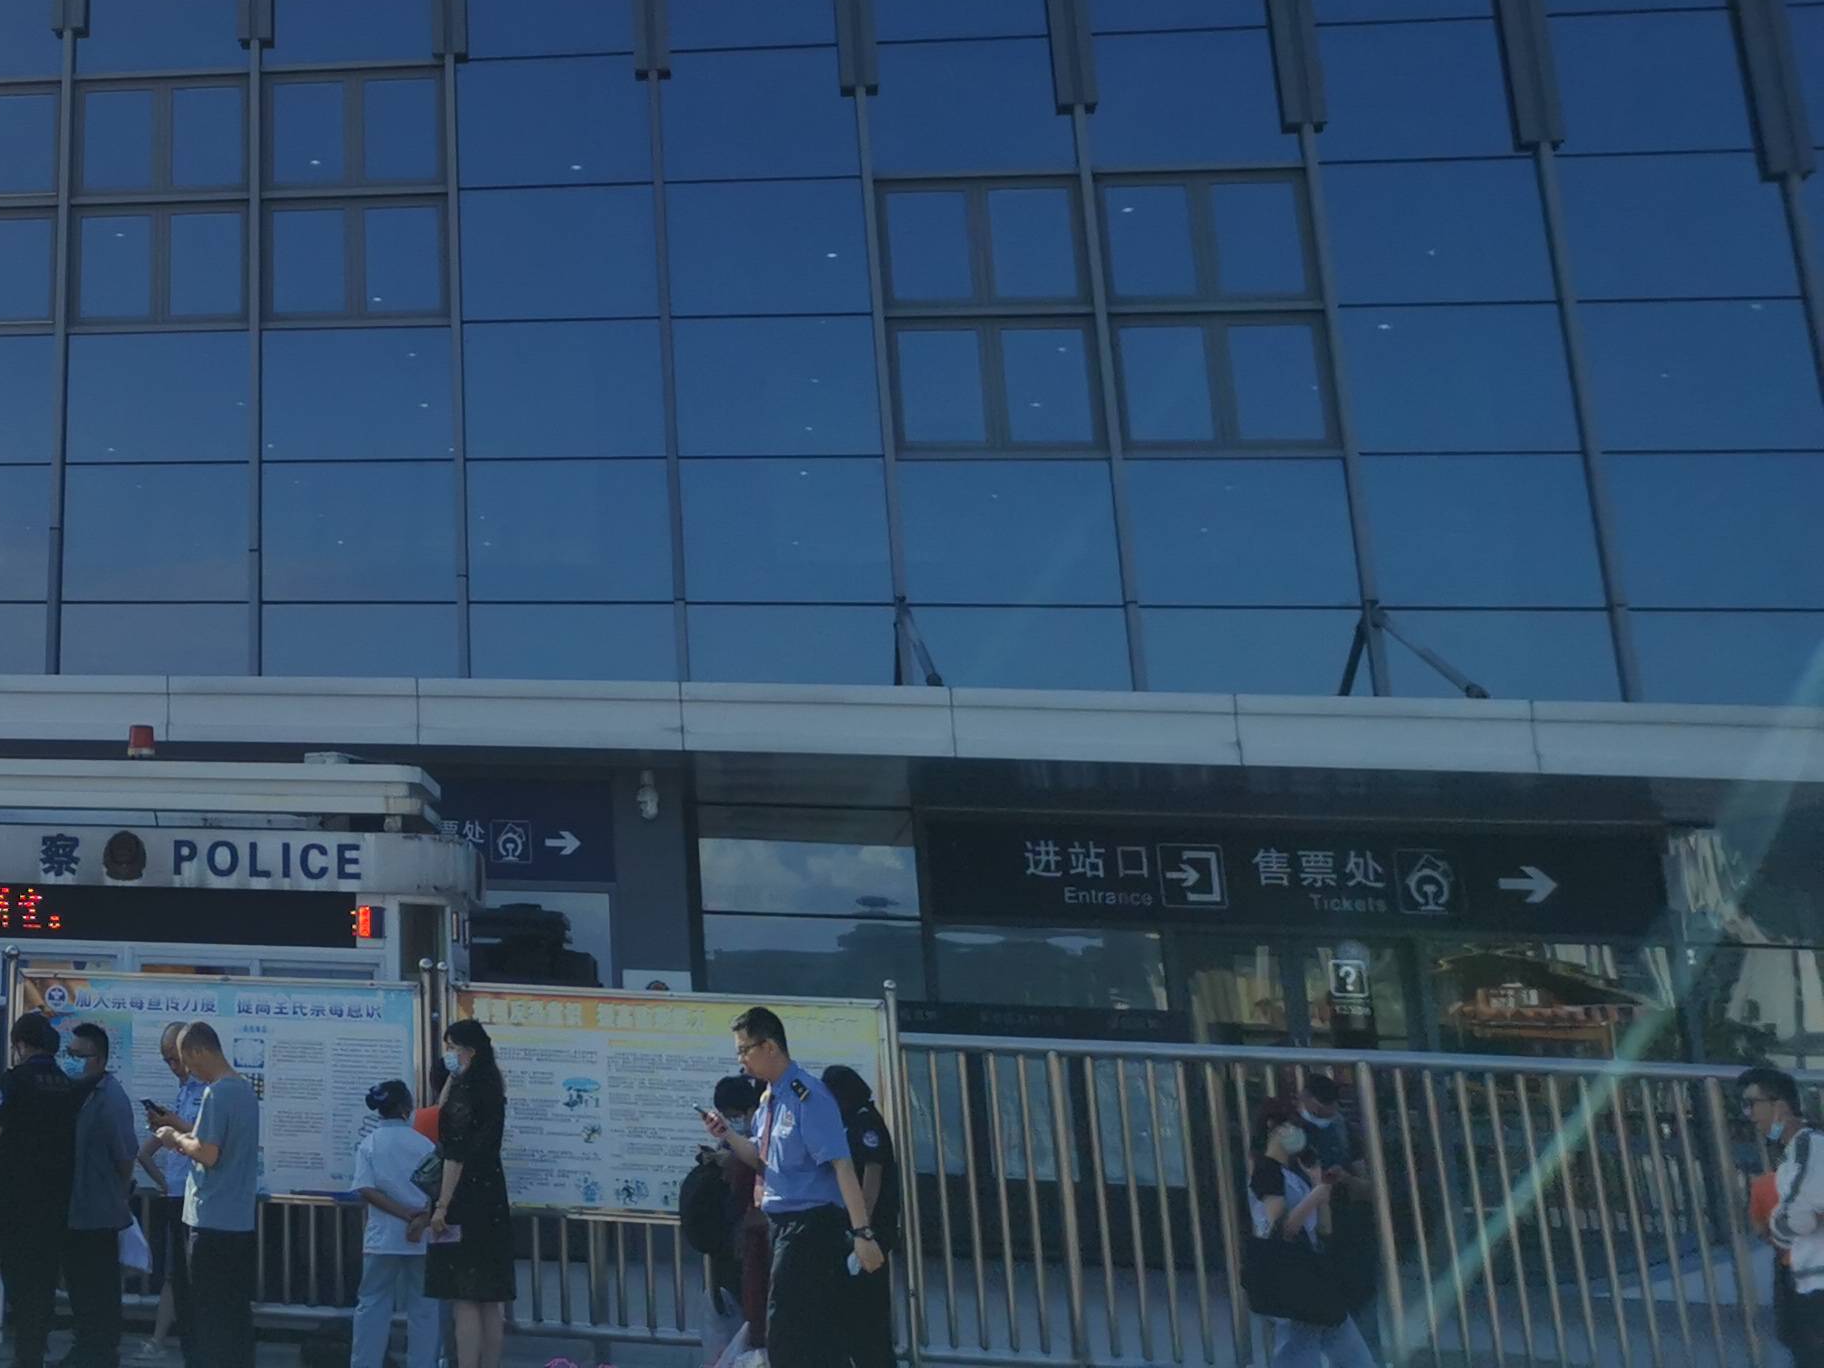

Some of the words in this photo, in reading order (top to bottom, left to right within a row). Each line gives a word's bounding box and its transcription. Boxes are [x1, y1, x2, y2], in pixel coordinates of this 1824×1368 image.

[173, 840, 362, 881] POLICE
[1024, 840, 1150, 880] 进站口
[1251, 847, 1385, 890] 售票处
[1064, 888, 1152, 907] Entrance
[1310, 893, 1386, 914] Tickets
